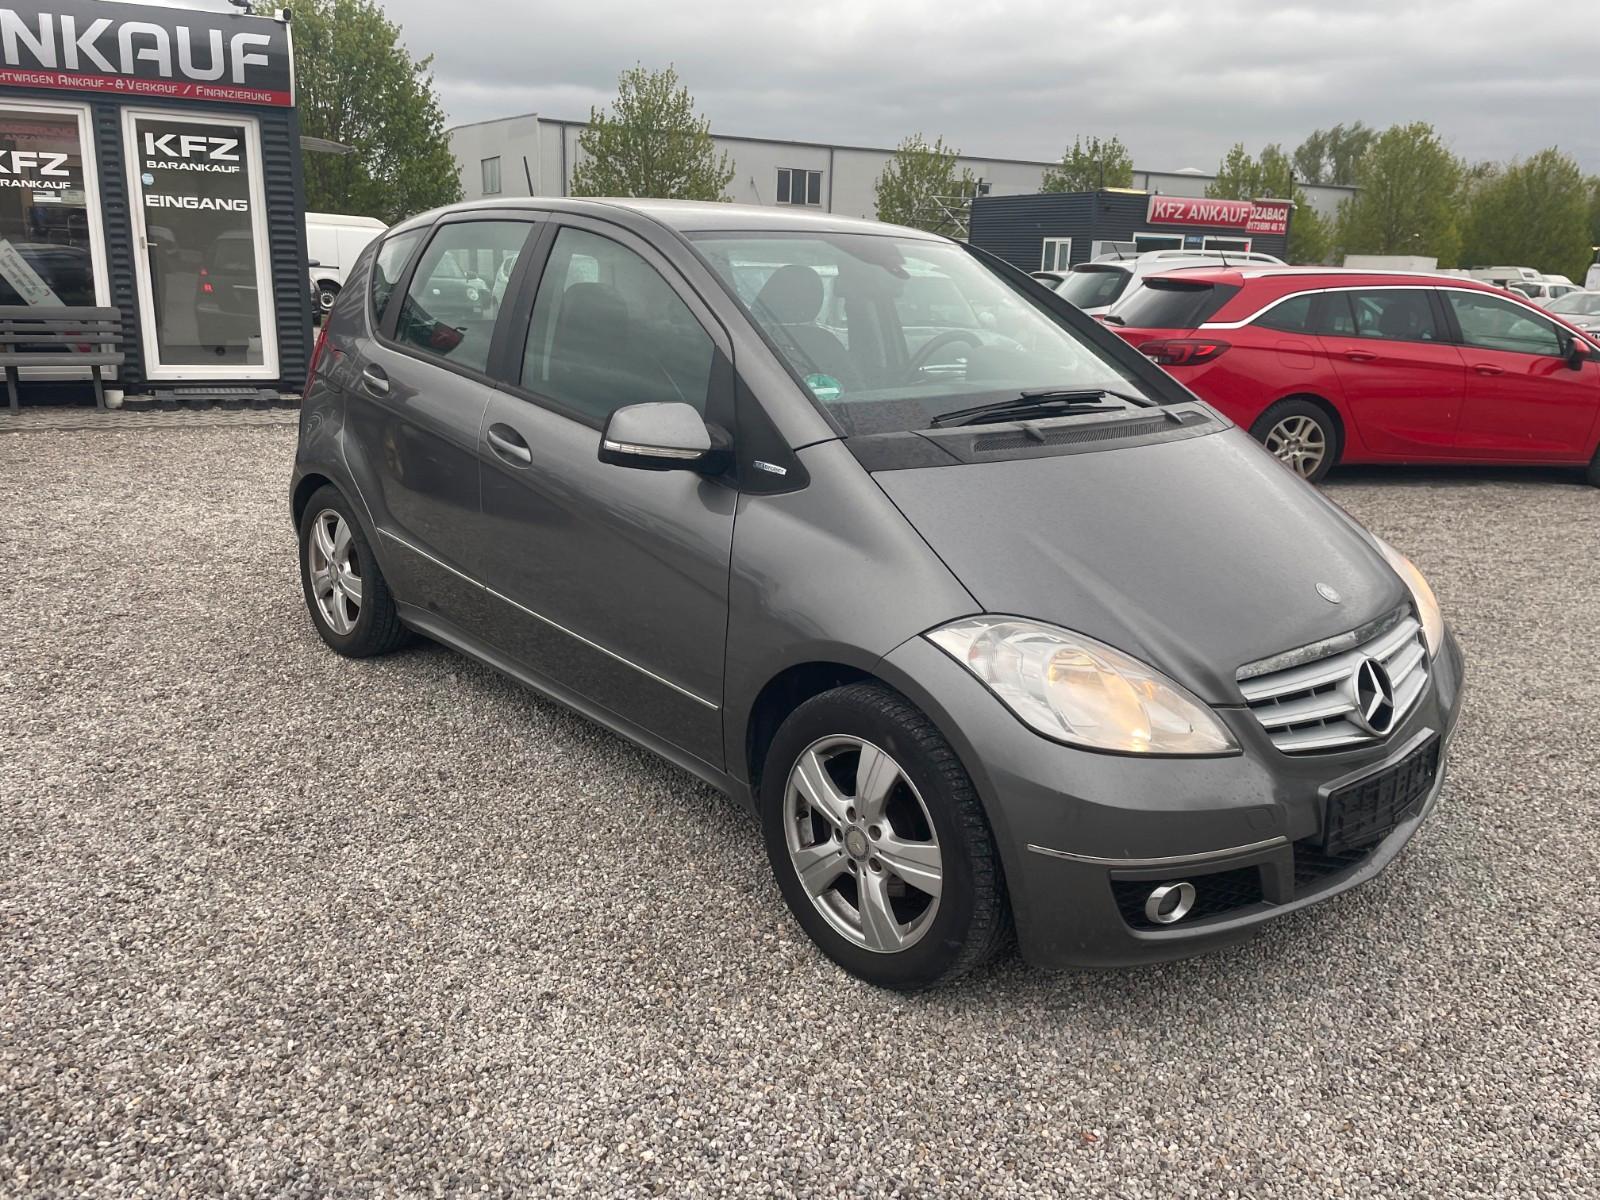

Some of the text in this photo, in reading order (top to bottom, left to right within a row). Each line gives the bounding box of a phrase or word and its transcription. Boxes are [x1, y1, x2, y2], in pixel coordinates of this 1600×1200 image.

[196, 86, 272, 102] FINANZIERUNG
[144, 132, 240, 161] KFZ
[146, 160, 240, 173] BARANKAUF
[145, 194, 248, 212] EINGANG
[1155, 201, 1250, 223] KFZ ANKAUF
